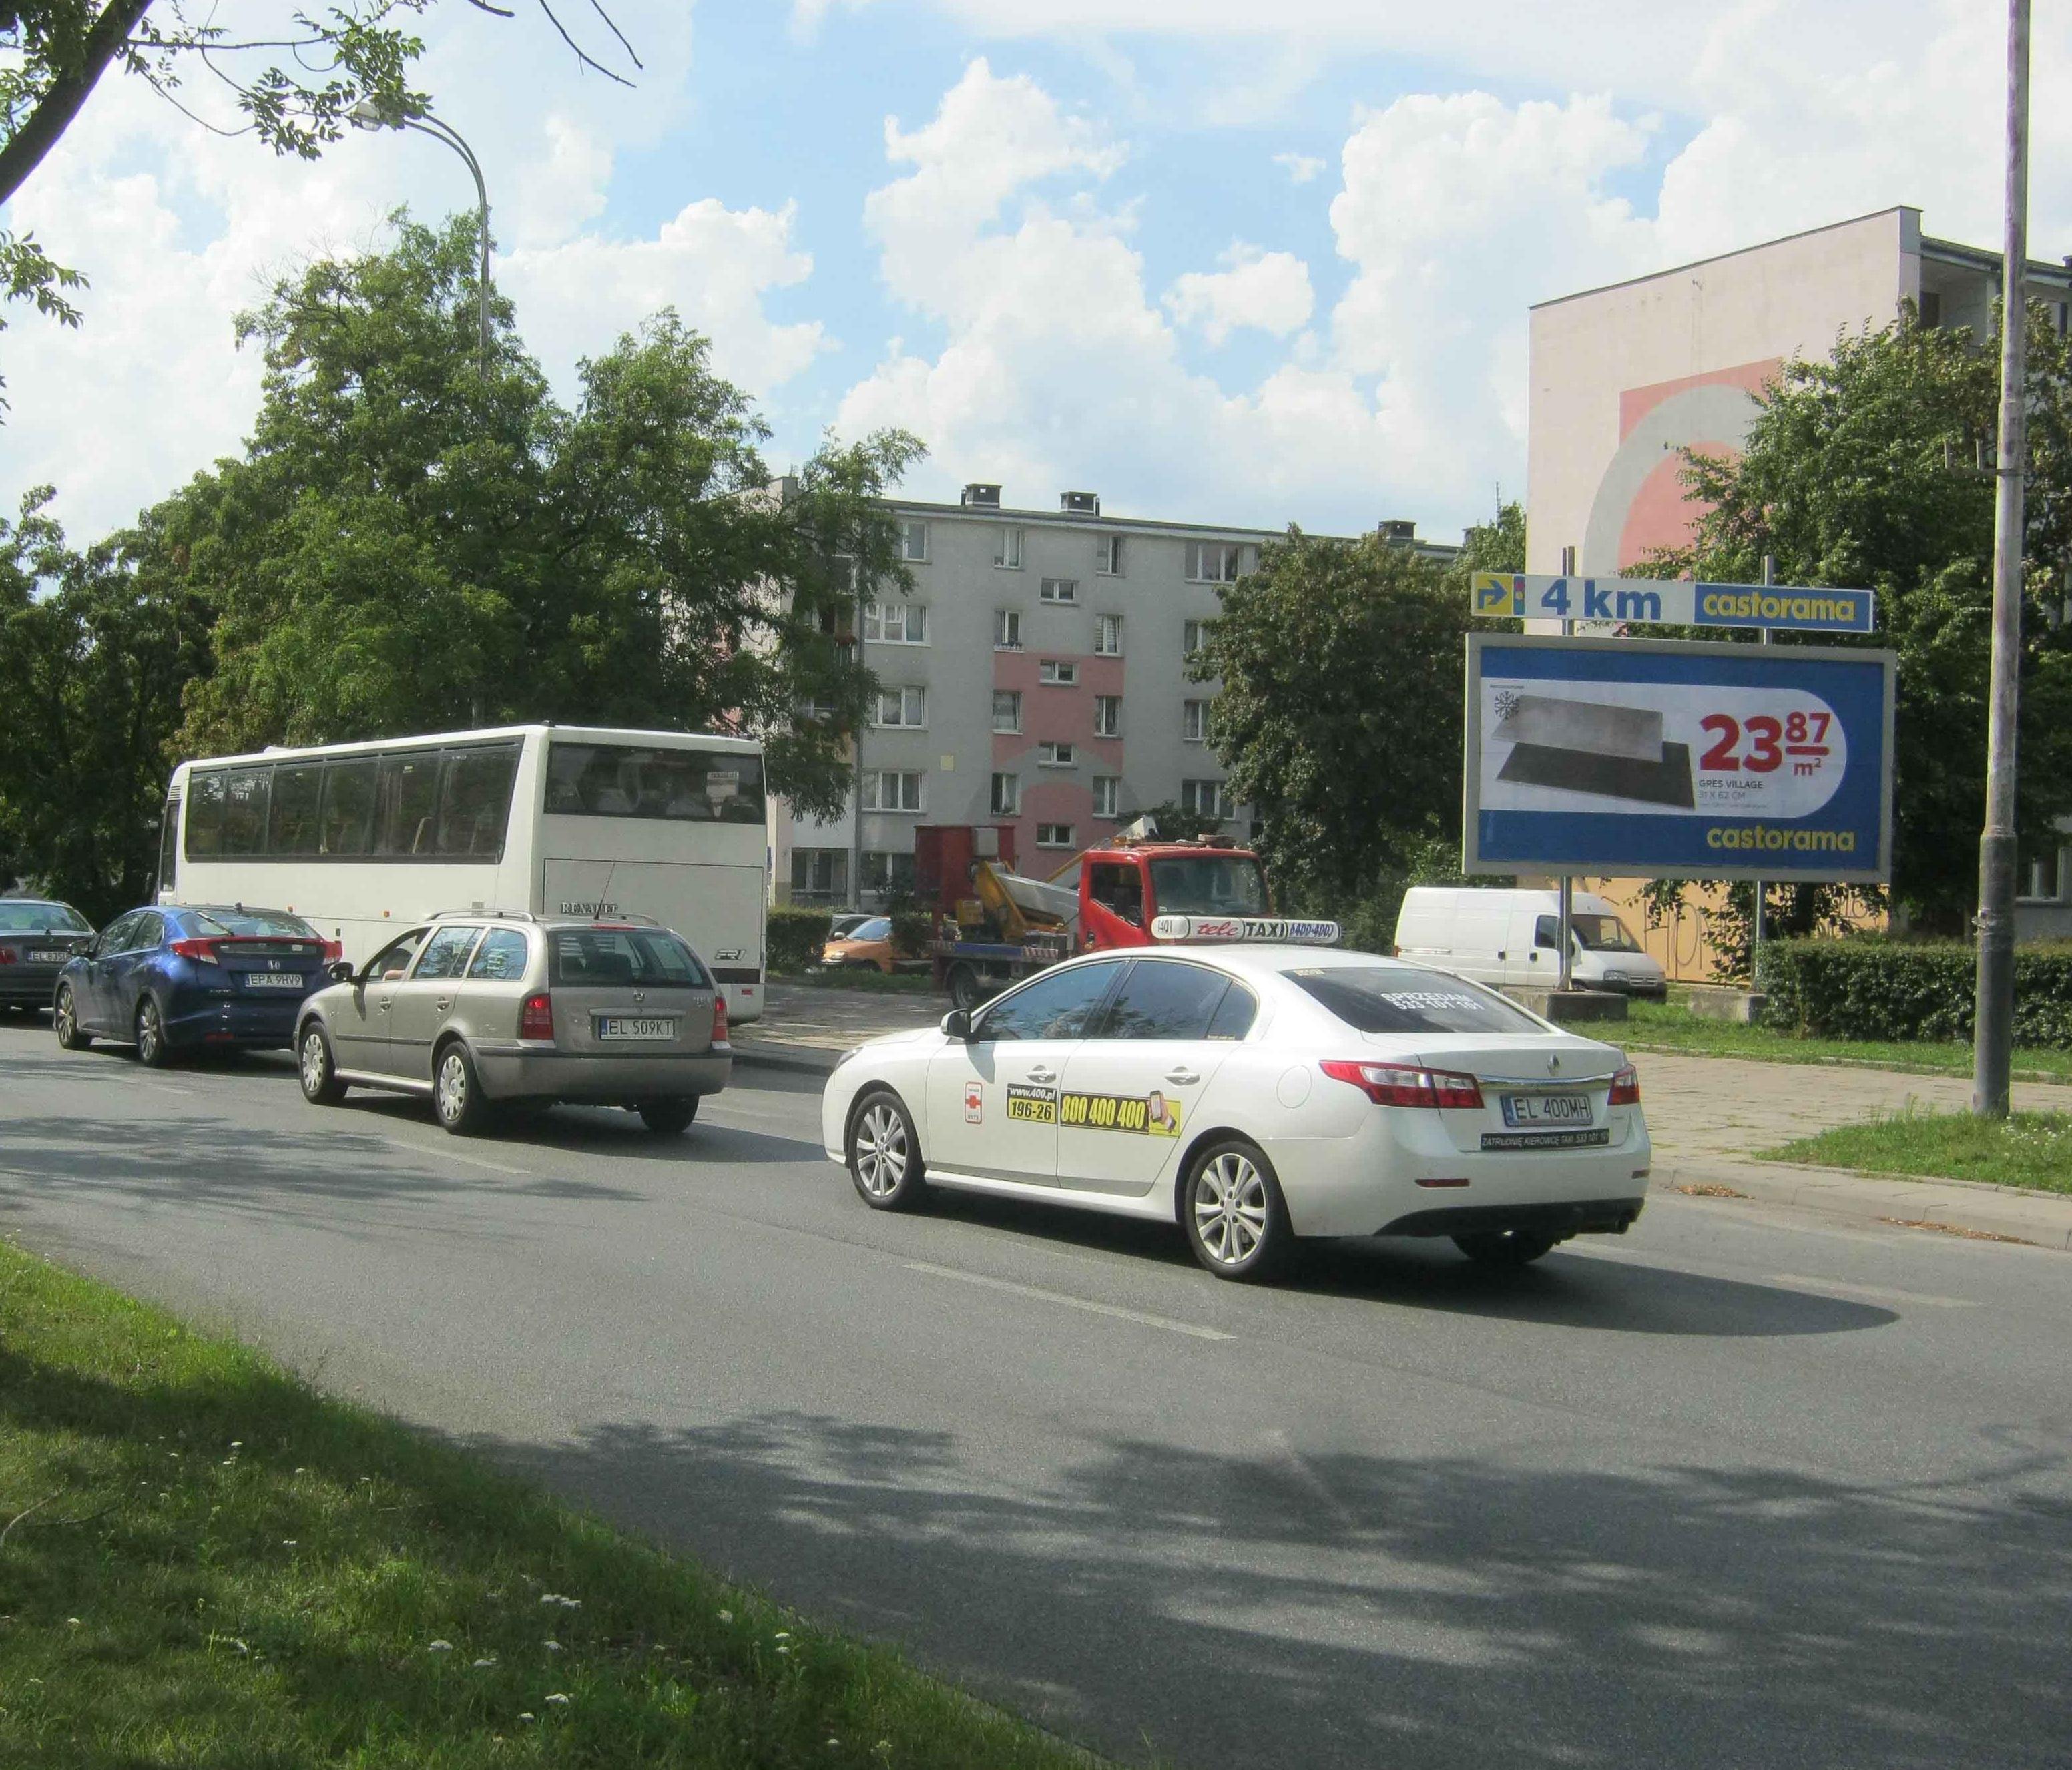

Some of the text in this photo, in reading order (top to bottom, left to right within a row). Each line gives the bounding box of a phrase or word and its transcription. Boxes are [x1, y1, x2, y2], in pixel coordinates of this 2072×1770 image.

[1541, 579, 1661, 621] 4 km
[1702, 591, 1856, 622] castorama
[1699, 780, 1764, 789] GRES VILLAGE
[1706, 826, 1856, 852] castorama
[1198, 921, 1238, 936] tele
[1246, 923, 1286, 938] TAXI
[250, 974, 274, 985] EPA
[609, 1020, 672, 1035] EL 509KT
[1009, 1087, 1055, 1101] www.400.pl
[1012, 1101, 1052, 1120] 196-26
[1061, 1095, 1146, 1129] 800 400 400
[1514, 1098, 1590, 1119] EL 400MH
